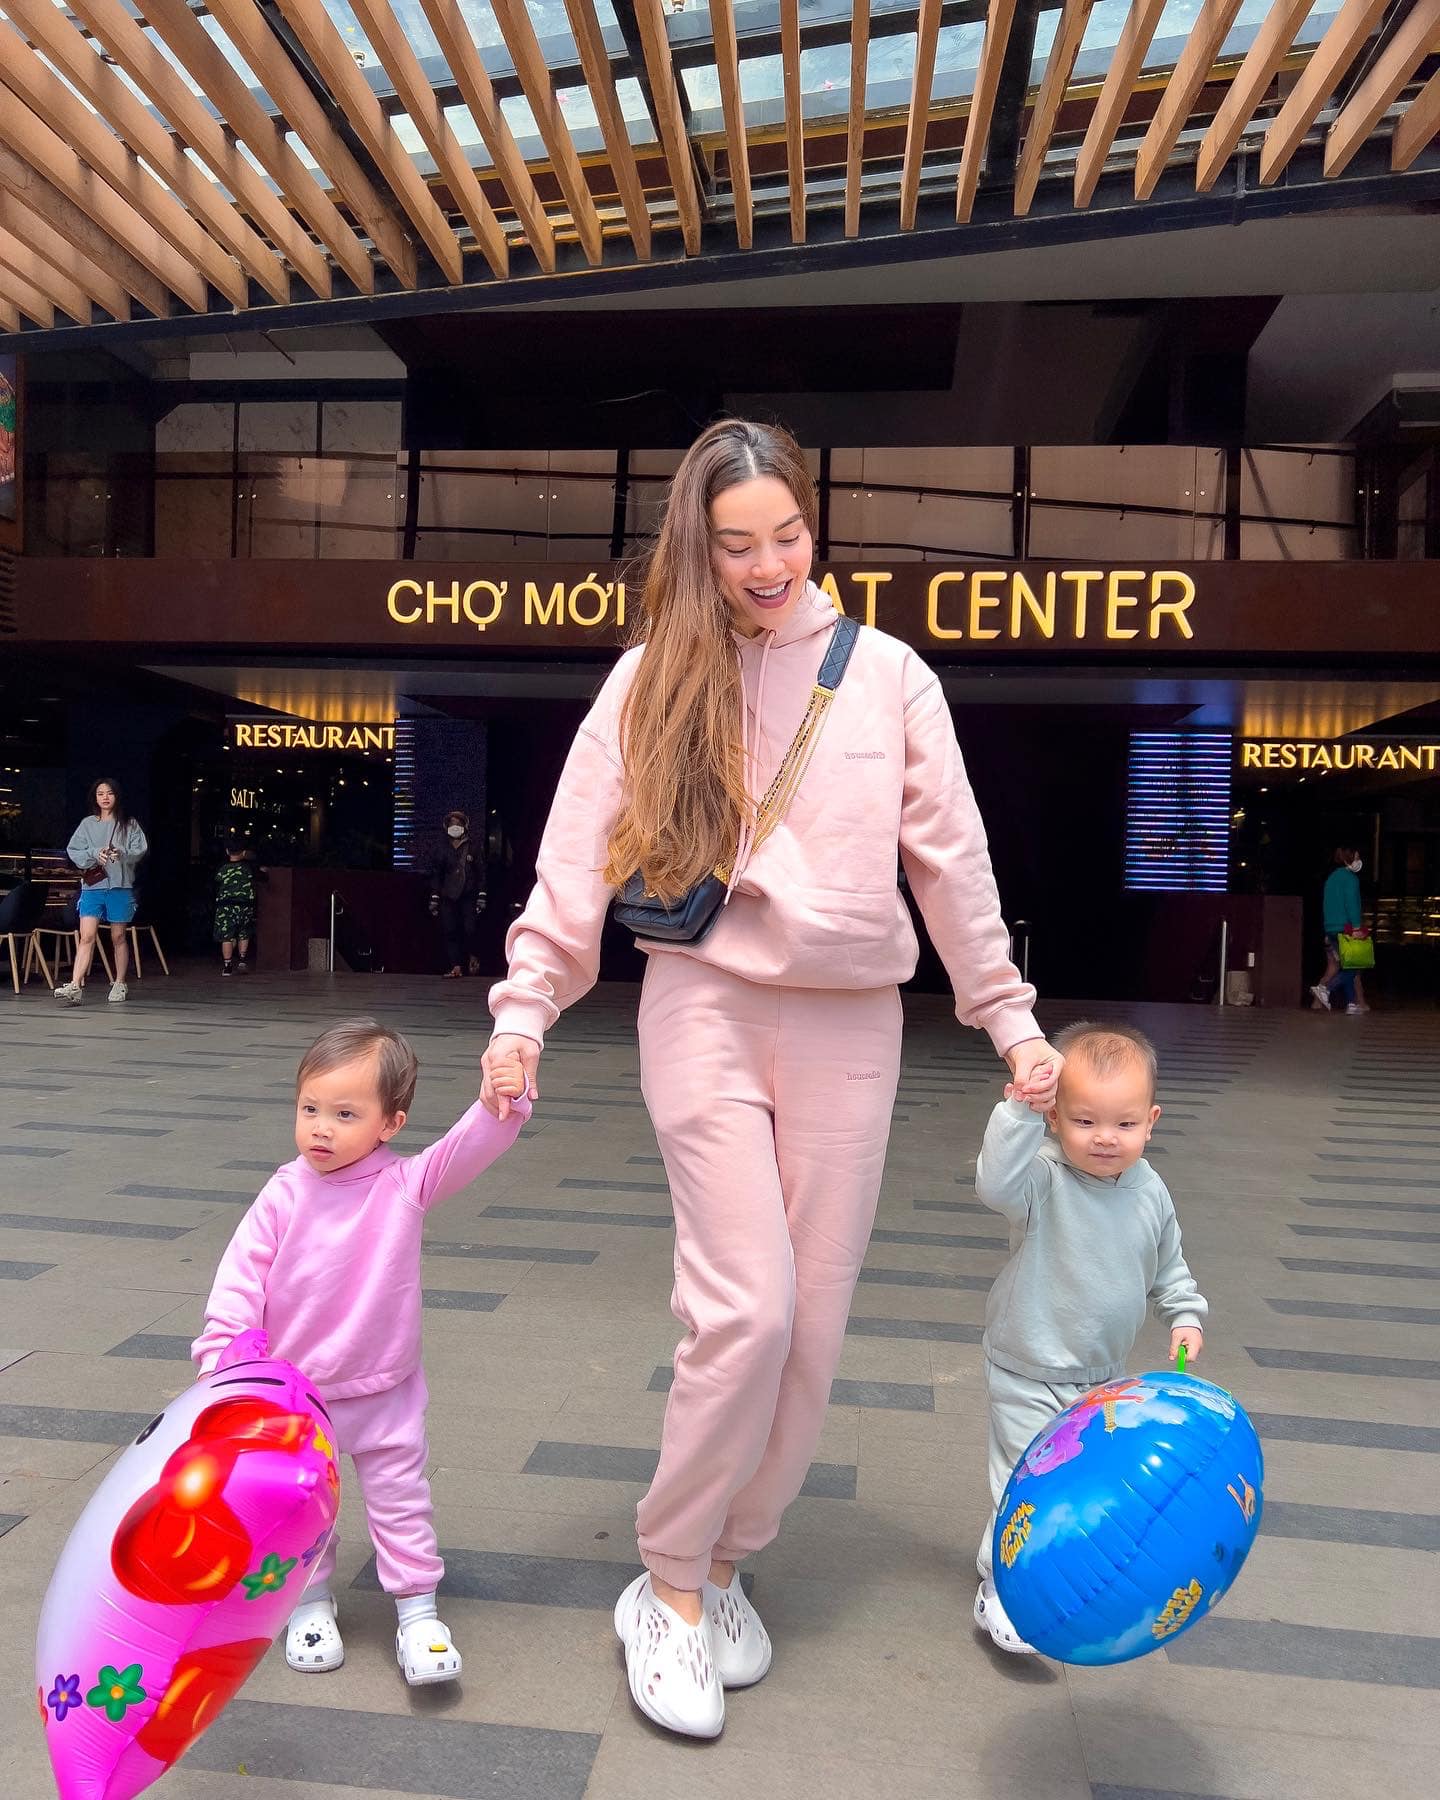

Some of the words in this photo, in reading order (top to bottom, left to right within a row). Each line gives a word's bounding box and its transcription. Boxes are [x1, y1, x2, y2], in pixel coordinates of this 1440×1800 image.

[387, 580, 508, 632] CHỢ
[524, 573, 626, 626] MỚI
[820, 572, 893, 629] AT
[927, 570, 1196, 640] CENTER
[236, 724, 395, 749] RESTAURANT
[1242, 742, 1440, 770] RESTAURANT
[230, 788, 256, 809] SALT
